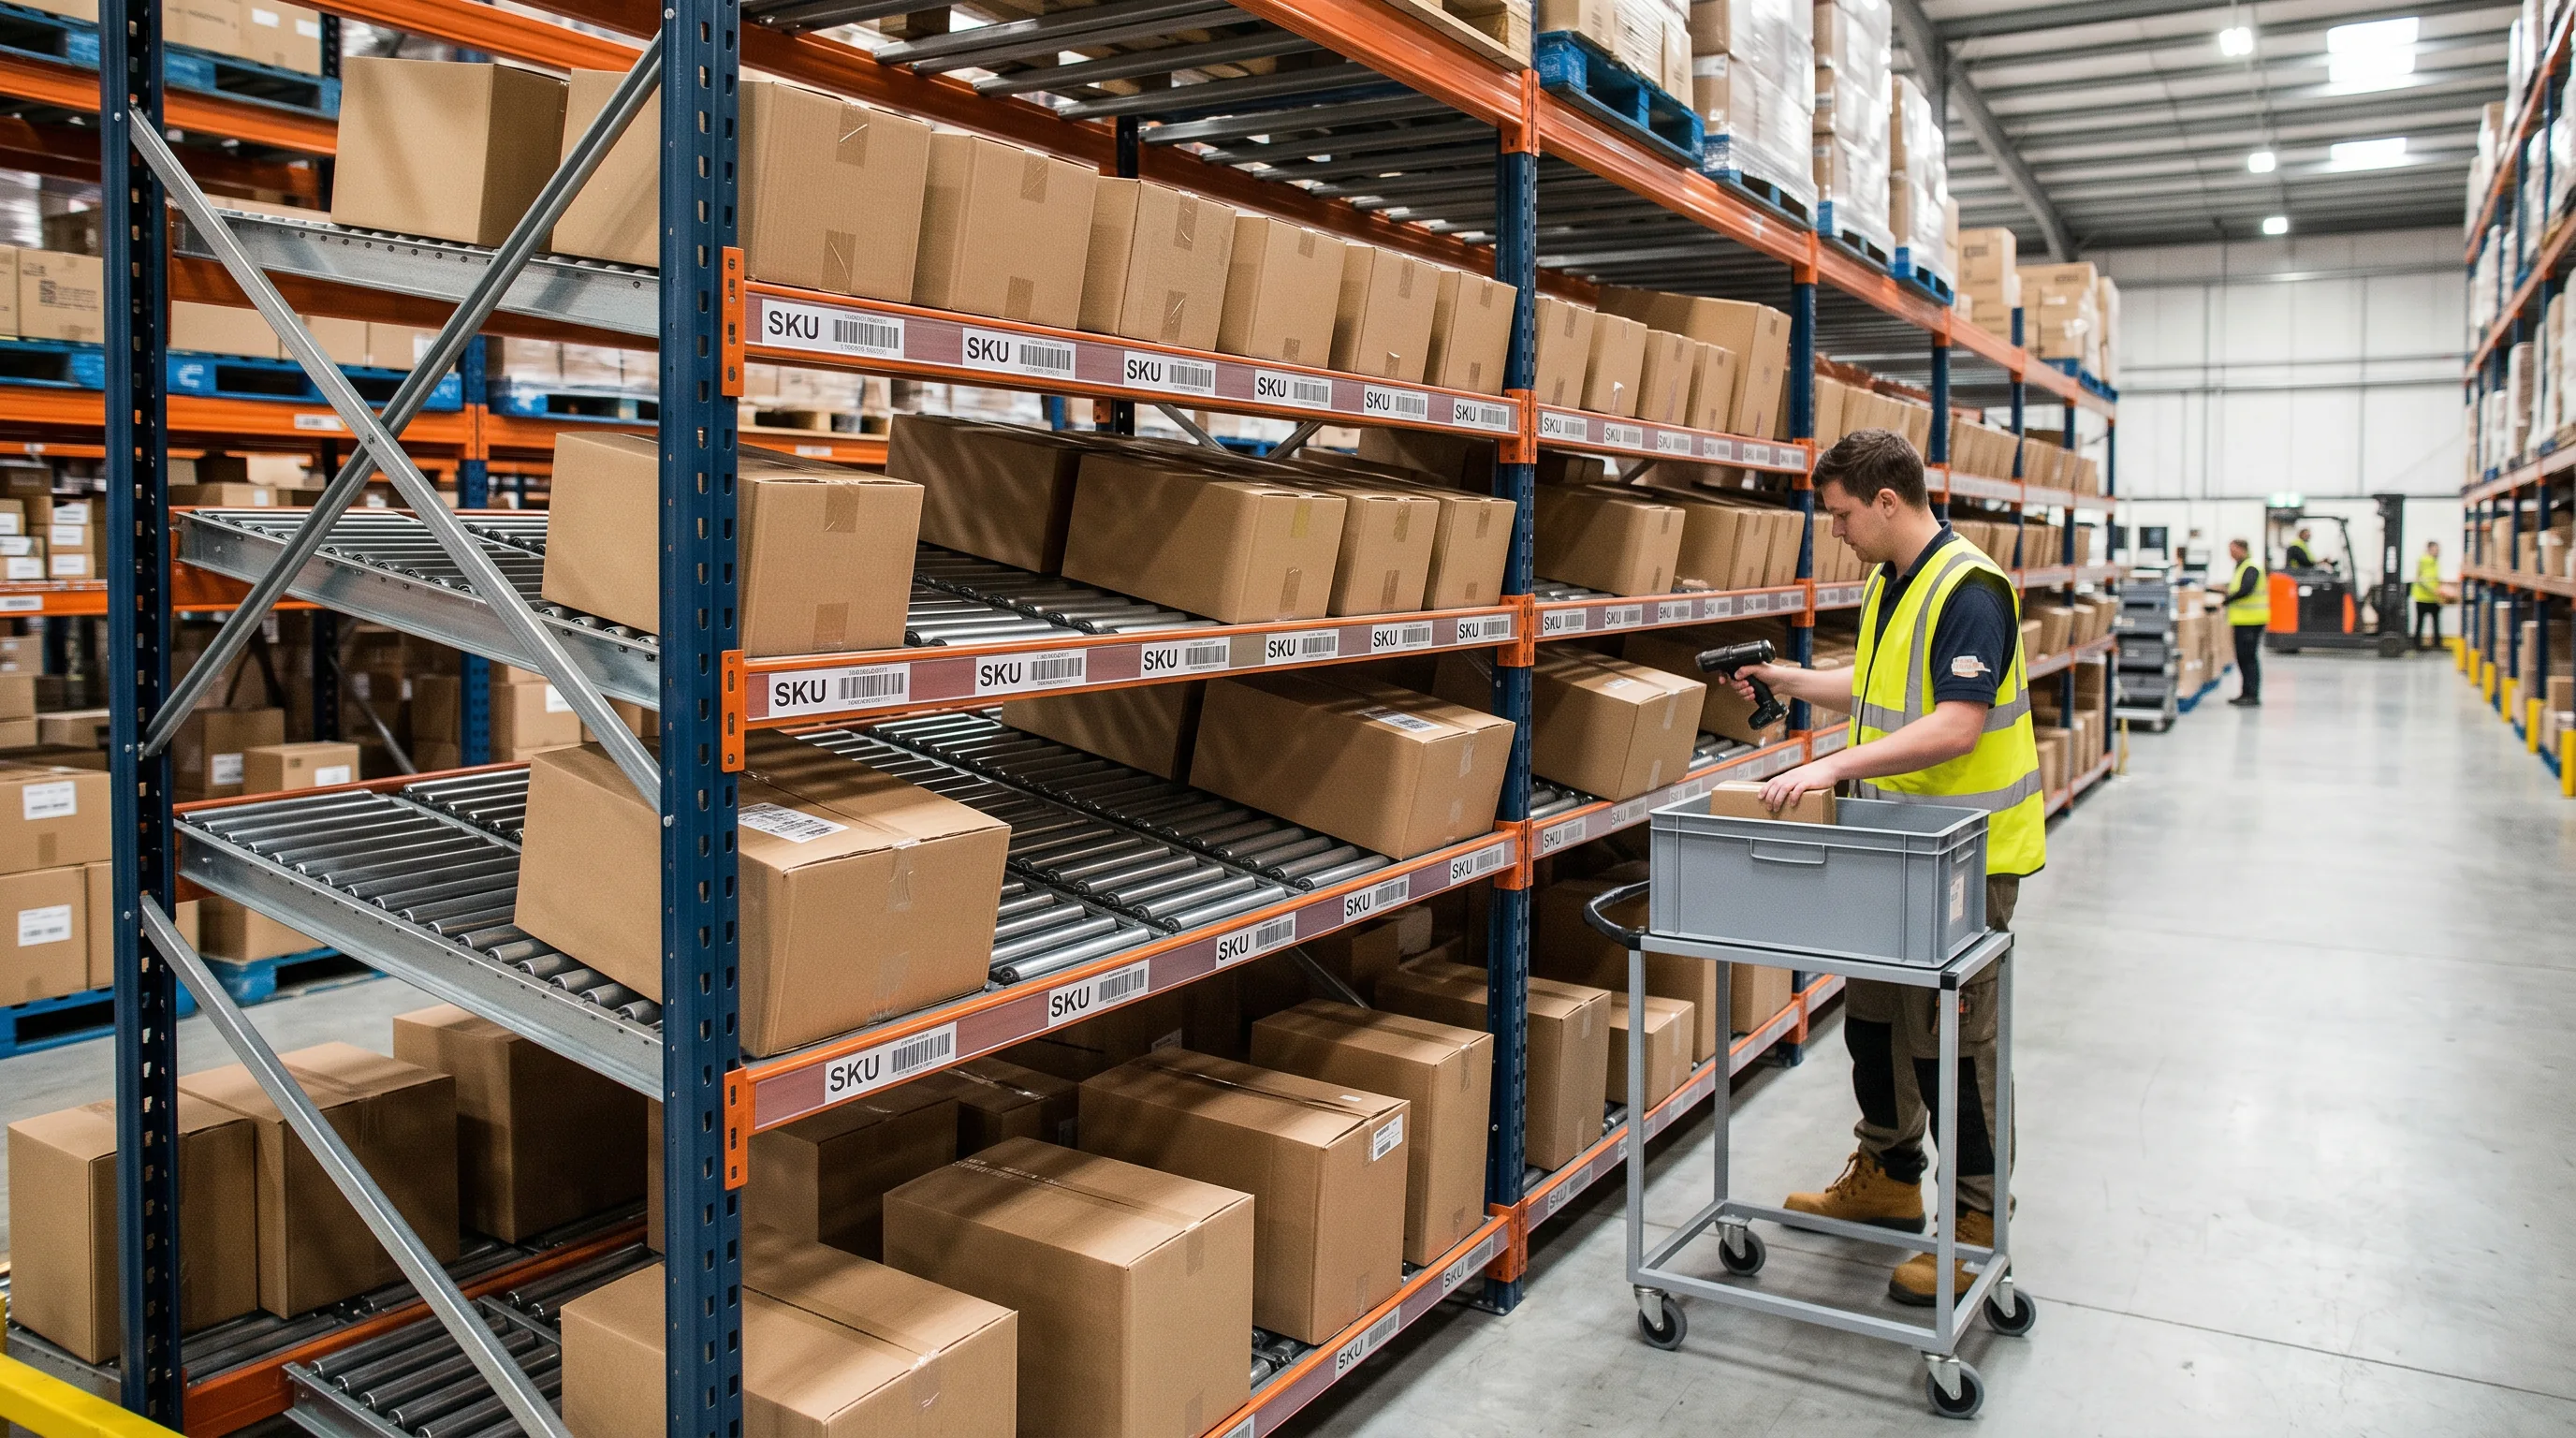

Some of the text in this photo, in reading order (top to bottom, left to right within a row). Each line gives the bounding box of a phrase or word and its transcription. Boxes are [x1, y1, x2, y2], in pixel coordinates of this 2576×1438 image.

[768, 310, 819, 340] SKU
[967, 336, 1009, 363] SKU
[1126, 359, 1162, 383] SKU
[1257, 376, 1286, 398] SKU
[1366, 391, 1390, 411] SKU
[1456, 404, 1476, 422] SKU
[1544, 417, 1561, 433] SKU
[1605, 428, 1621, 442] SKU
[1606, 610, 1621, 625] SKU
[1373, 629, 1398, 648] SKU
[1458, 622, 1479, 639] SKU
[1144, 648, 1178, 671] SKU
[1267, 638, 1296, 659] SKU
[979, 662, 1022, 687] SKU
[774, 678, 827, 707] SKU
[1452, 858, 1472, 879] SKU
[1346, 892, 1370, 917] SKU
[1219, 932, 1250, 961] SKU
[1051, 985, 1090, 1018] SKU
[829, 1054, 880, 1093] SKU
[1444, 1261, 1465, 1288] SKU
[1339, 1339, 1364, 1370] SKU
